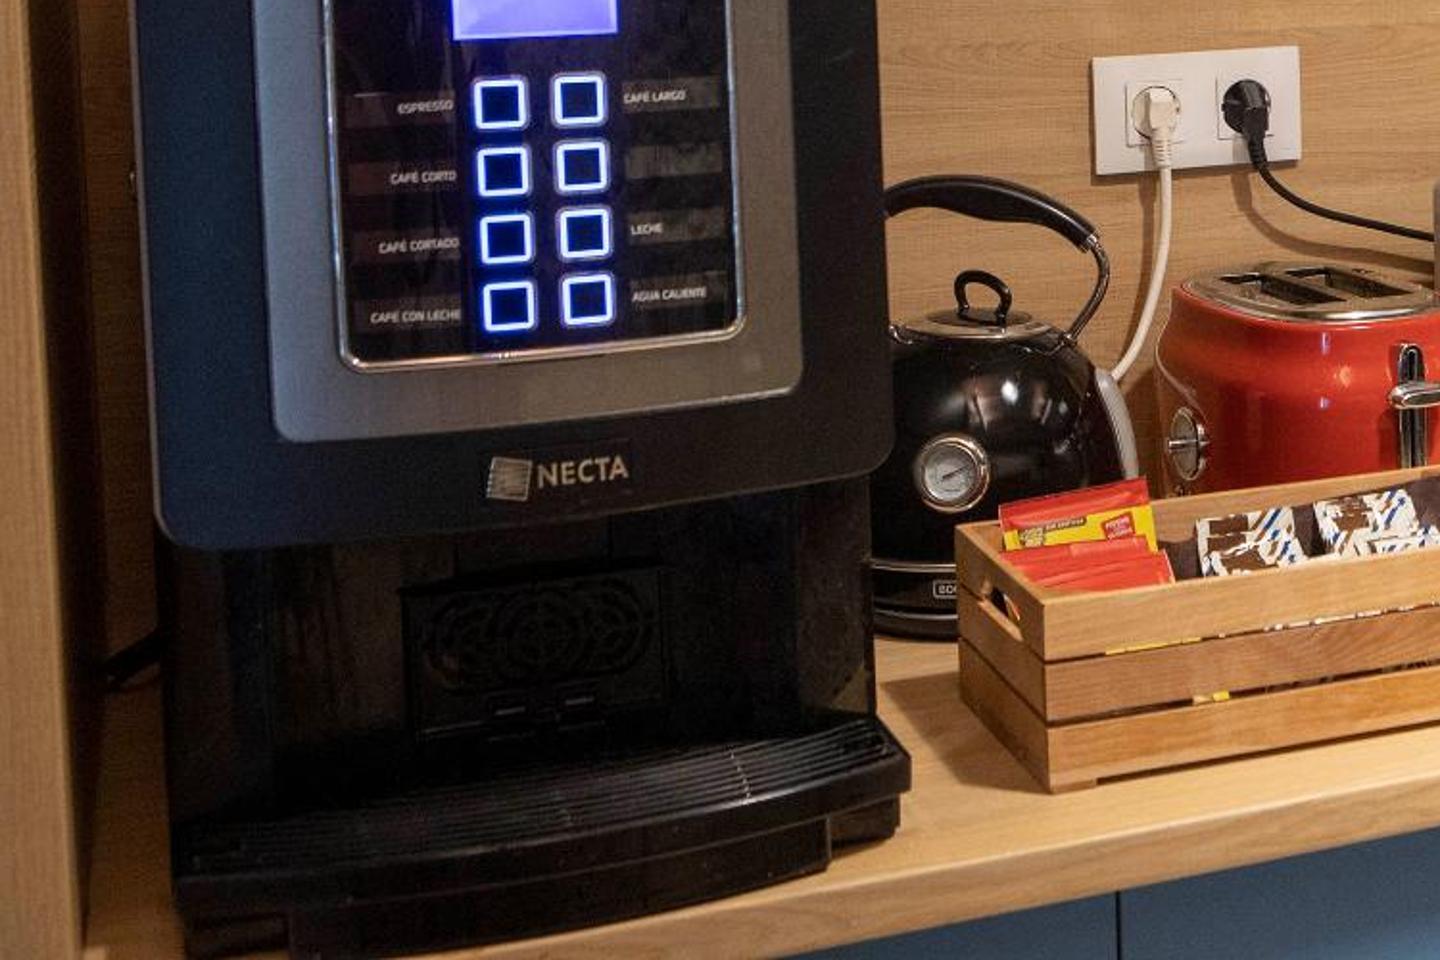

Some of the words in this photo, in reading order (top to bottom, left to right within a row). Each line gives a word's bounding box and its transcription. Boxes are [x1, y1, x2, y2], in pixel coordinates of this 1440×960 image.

[651, 89, 687, 103] LARGO
[397, 99, 455, 115] ESPRESSO
[421, 169, 457, 183] CORTO
[630, 222, 664, 235] LECHE
[409, 237, 461, 252] CORTADO
[632, 289, 660, 302] AGUA
[661, 285, 708, 300] CALIENTE
[401, 309, 425, 323] CON
[426, 307, 462, 322] LECHE
[536, 454, 630, 489] NECTA
